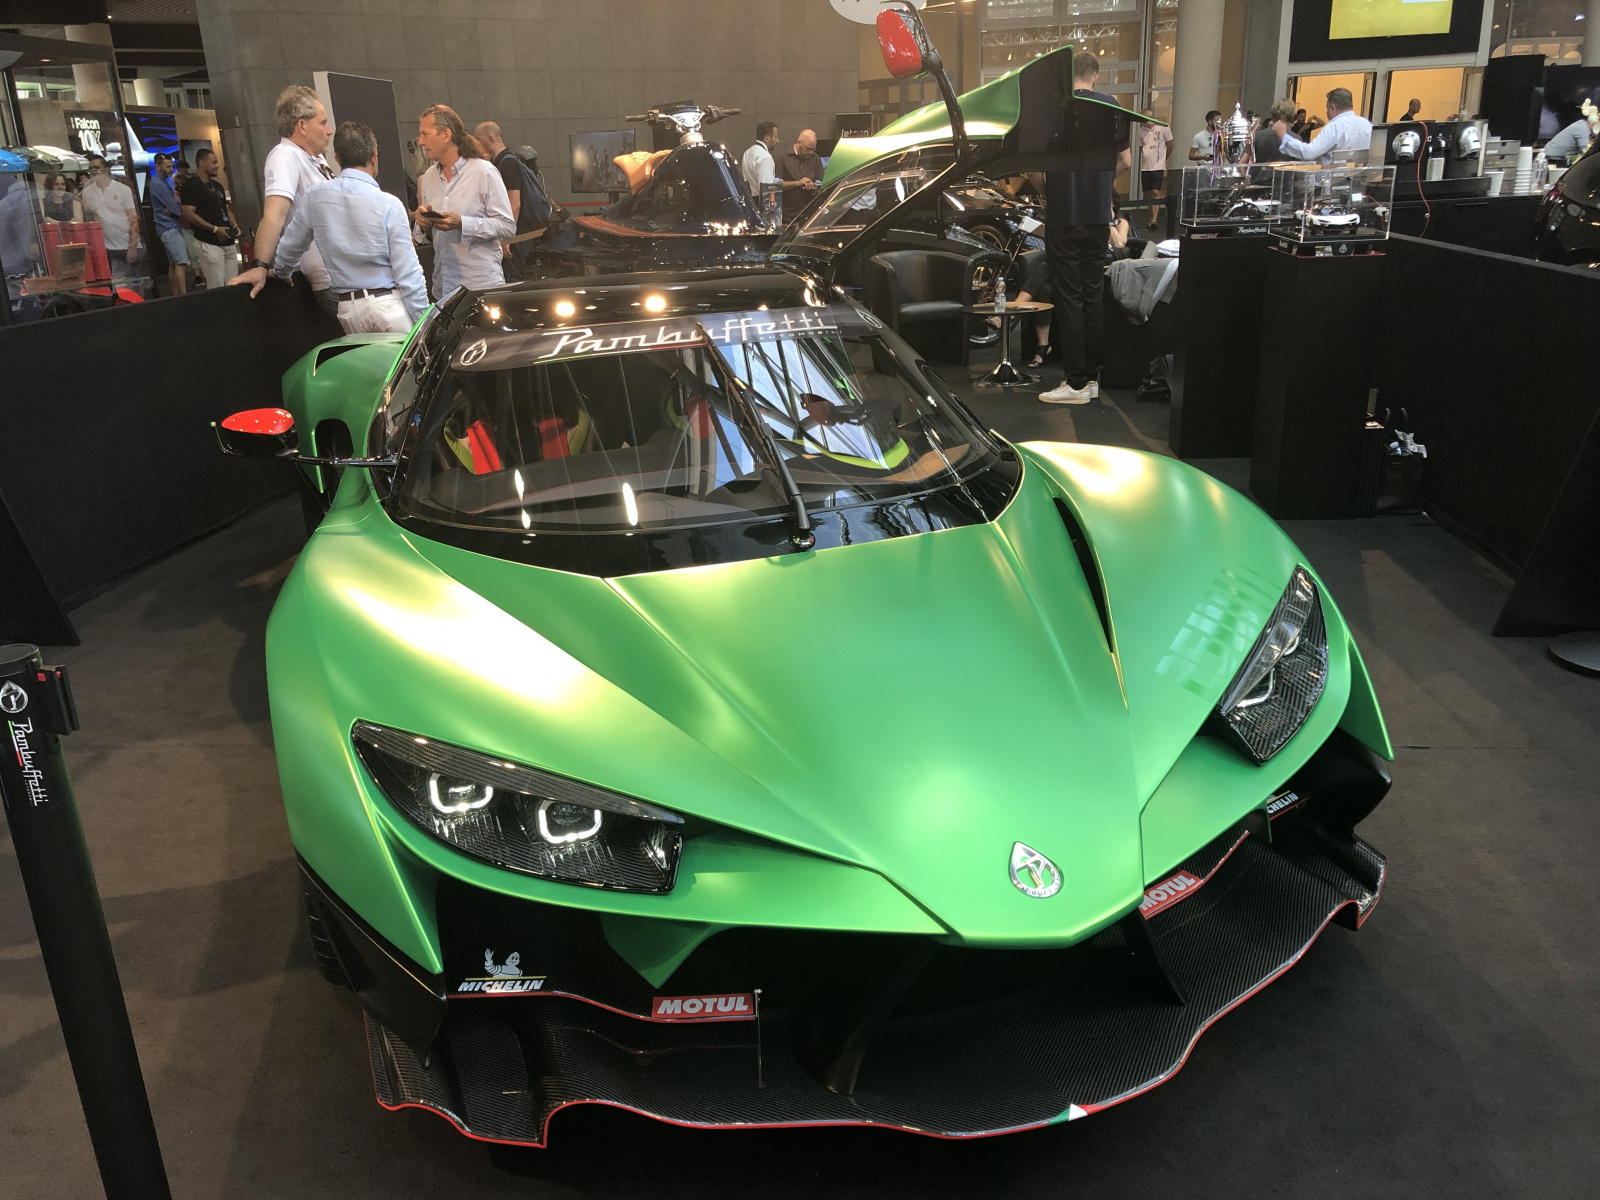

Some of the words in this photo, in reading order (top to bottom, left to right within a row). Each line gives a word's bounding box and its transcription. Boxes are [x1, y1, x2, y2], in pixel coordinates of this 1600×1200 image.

[74, 117, 100, 130] Falcon
[78, 130, 104, 151] 10X
[536, 311, 838, 360] Pambuffetti
[759, 329, 843, 340] AUTOMOBILI
[11, 716, 49, 807] Pambuffetti
[1266, 792, 1299, 814] CHELIN
[1138, 874, 1196, 911] MOTUL
[458, 980, 544, 992] MICHELIN
[657, 996, 749, 1014] MOTUL
